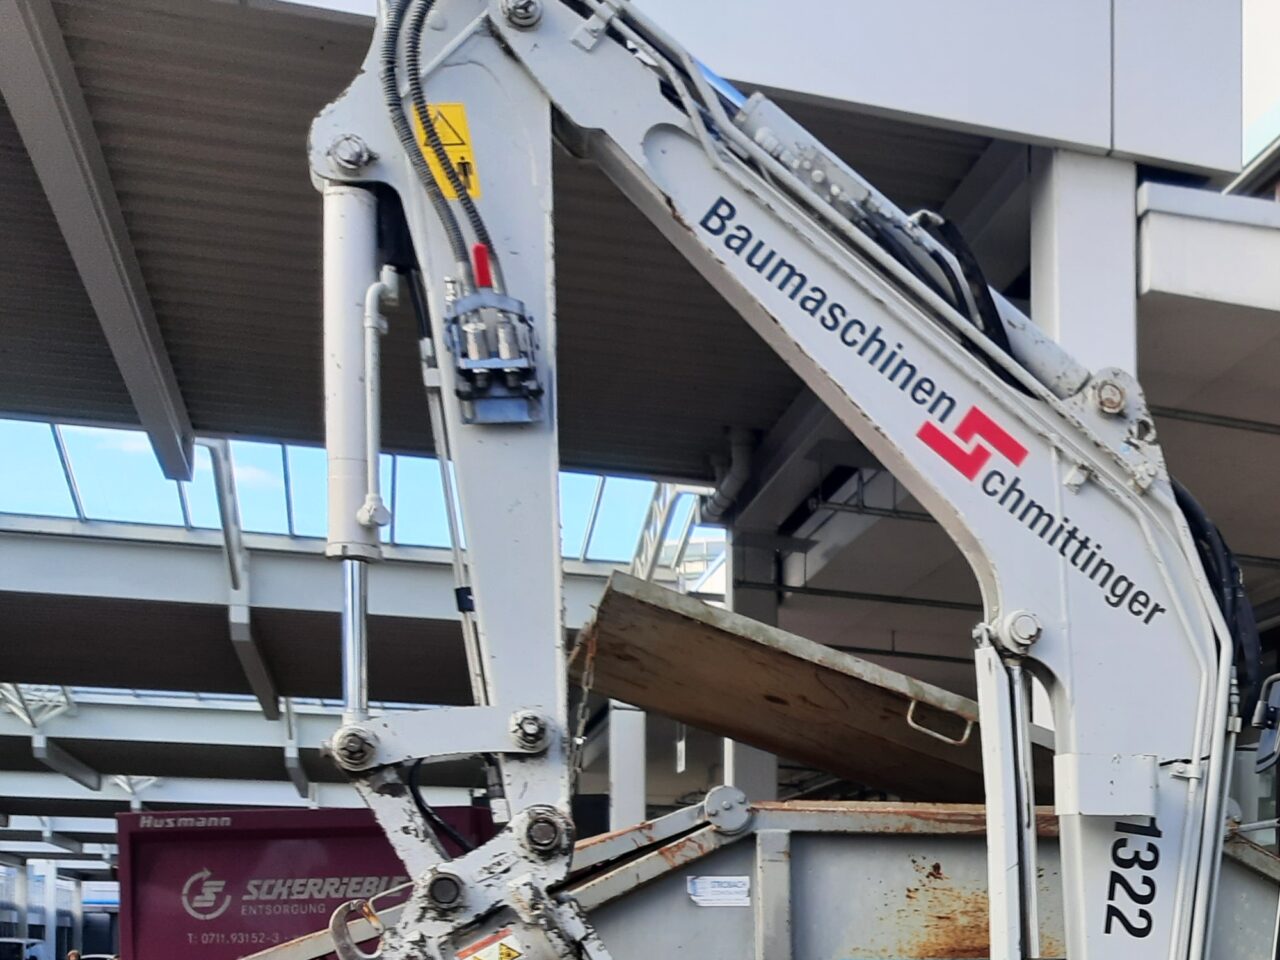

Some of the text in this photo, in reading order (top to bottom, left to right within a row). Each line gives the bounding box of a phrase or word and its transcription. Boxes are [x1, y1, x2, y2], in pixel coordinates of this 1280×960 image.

[699, 196, 957, 423] Baumaschinen
[139, 816, 231, 828] Husmann
[241, 903, 326, 915] ENTSORGUNG
[1104, 817, 1162, 938] 1322
